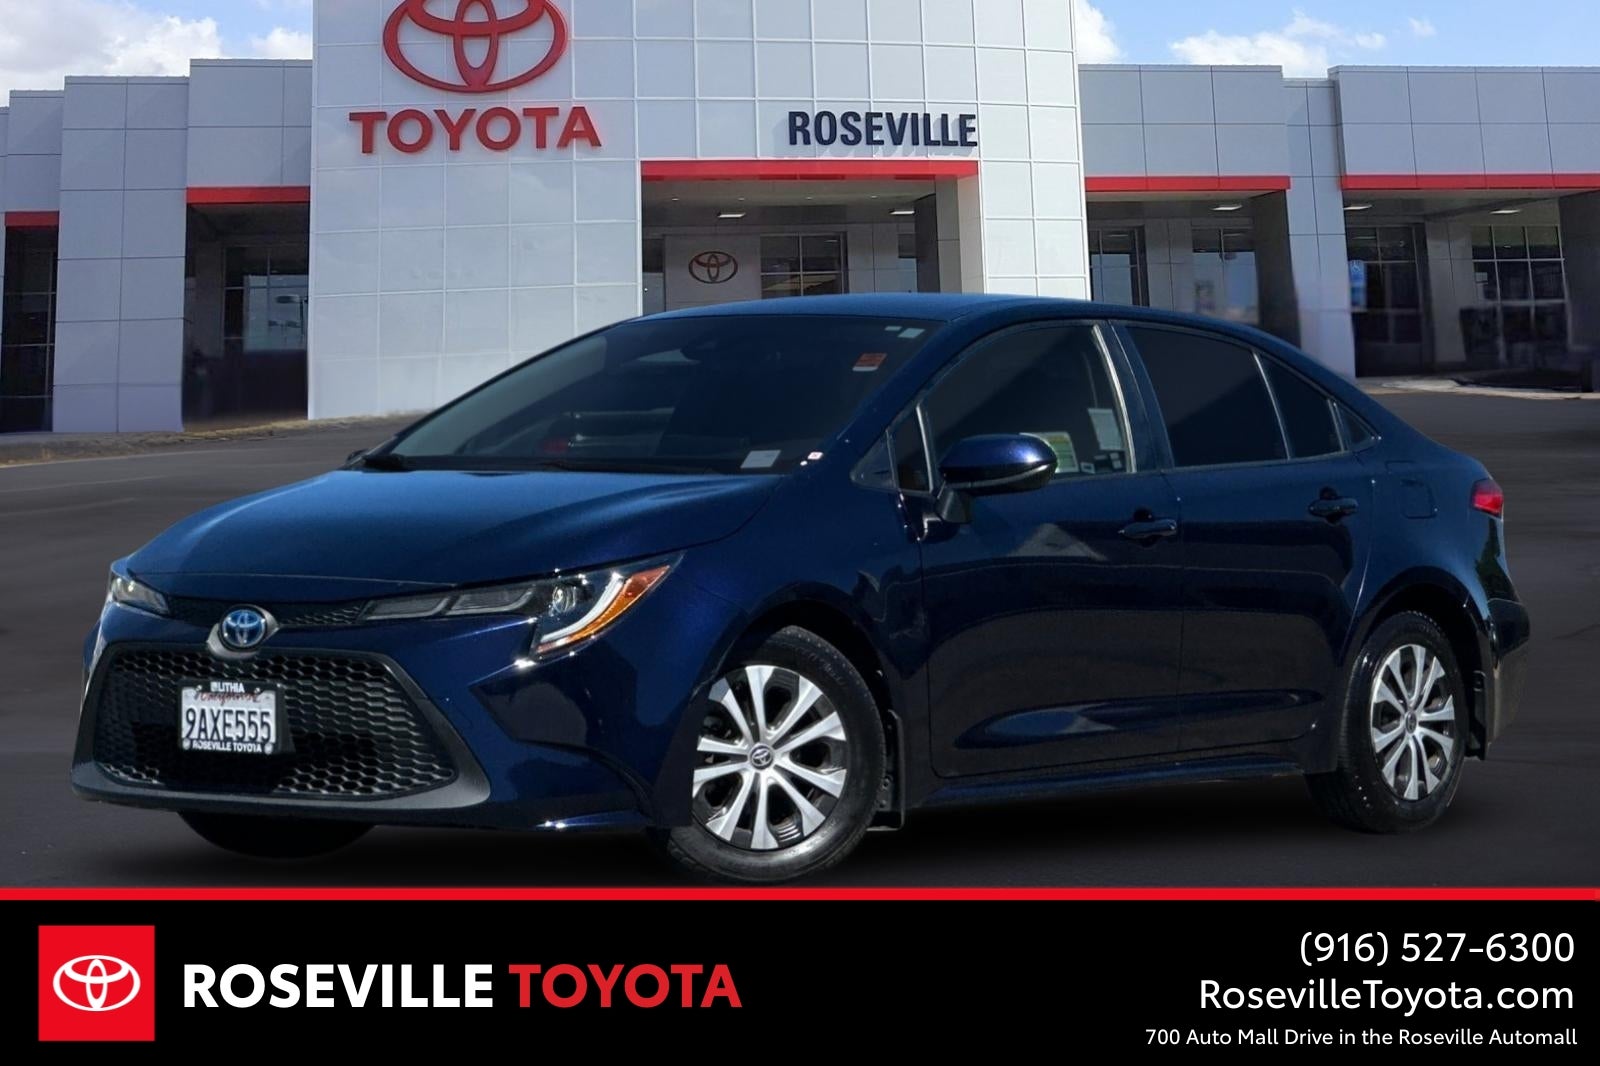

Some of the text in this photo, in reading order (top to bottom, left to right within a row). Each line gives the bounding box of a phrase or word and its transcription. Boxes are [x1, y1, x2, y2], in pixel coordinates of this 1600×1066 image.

[349, 105, 602, 153] TOYOTA
[788, 110, 979, 147] ROSEVILLE
[218, 682, 245, 693] LITHIA
[185, 708, 271, 742] 9AXE555
[192, 741, 262, 753] ROSEVILLE TOYOTA
